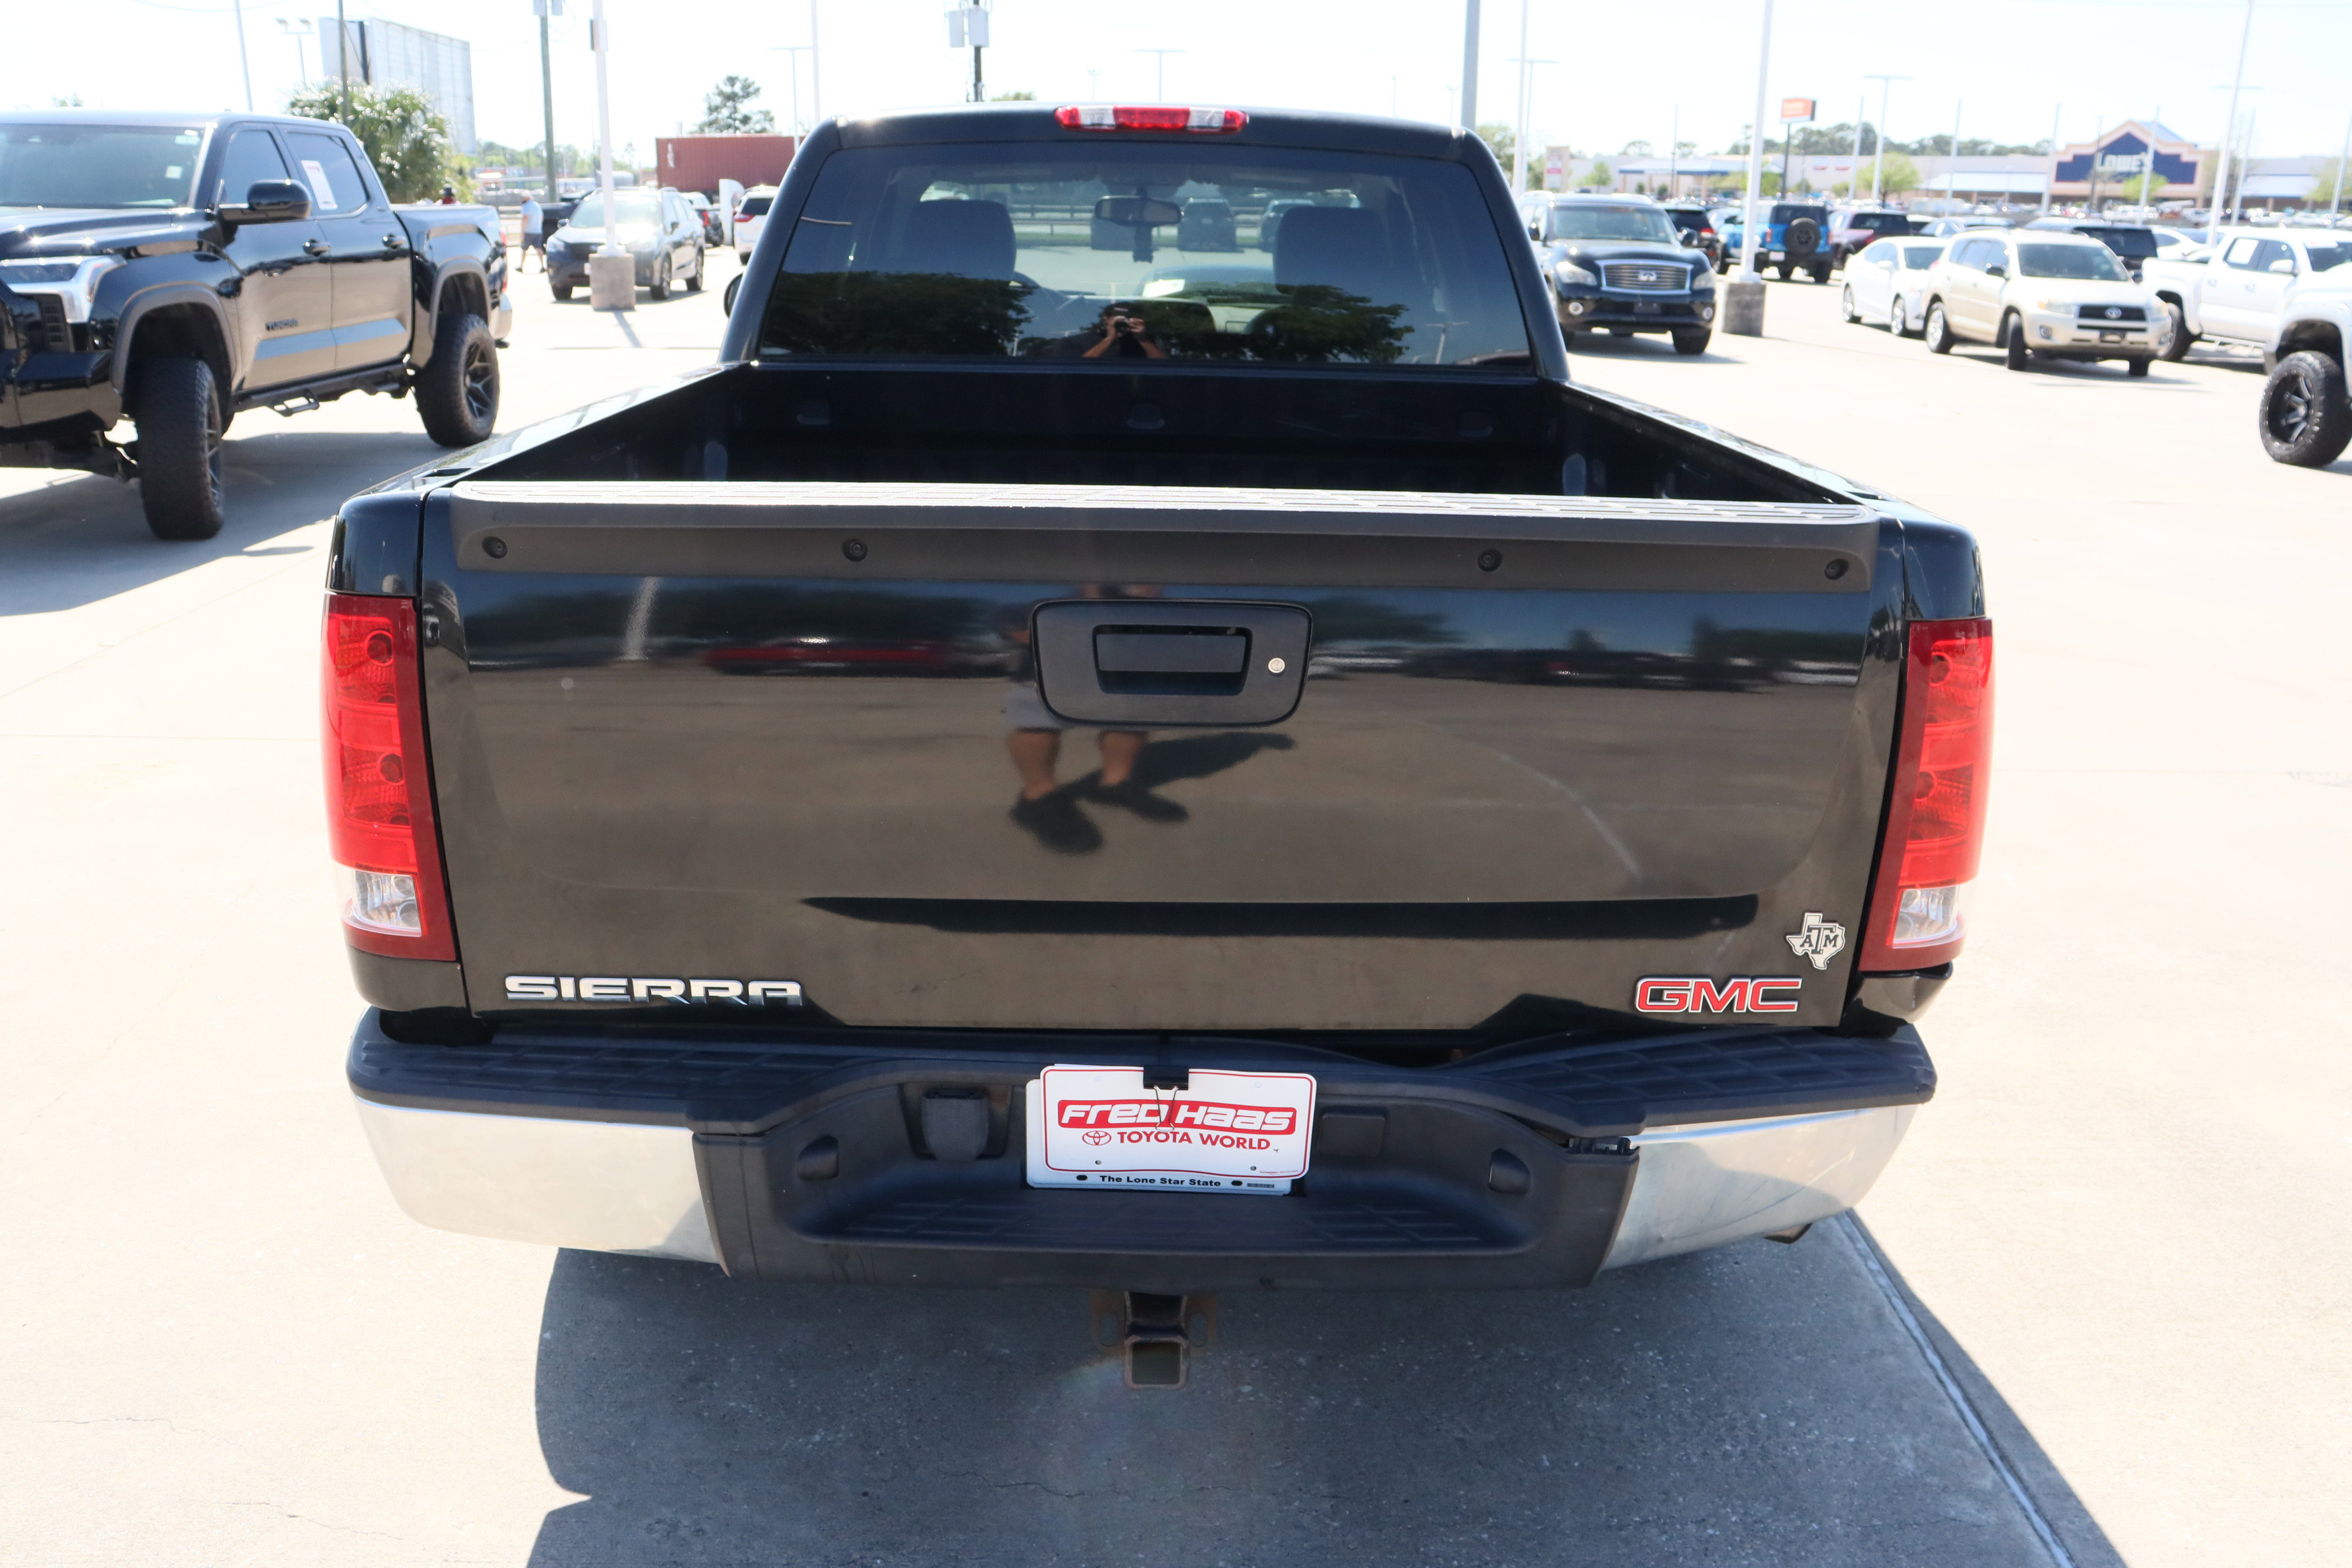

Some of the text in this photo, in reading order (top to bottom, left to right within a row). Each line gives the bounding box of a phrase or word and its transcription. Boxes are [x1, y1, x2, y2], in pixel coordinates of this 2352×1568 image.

[505, 975, 803, 1006] SIERRA
[1636, 978, 1802, 1013] GMC
[1117, 1131, 1270, 1150] TOYOTA WORLD
[1188, 1178, 1221, 1187] State
